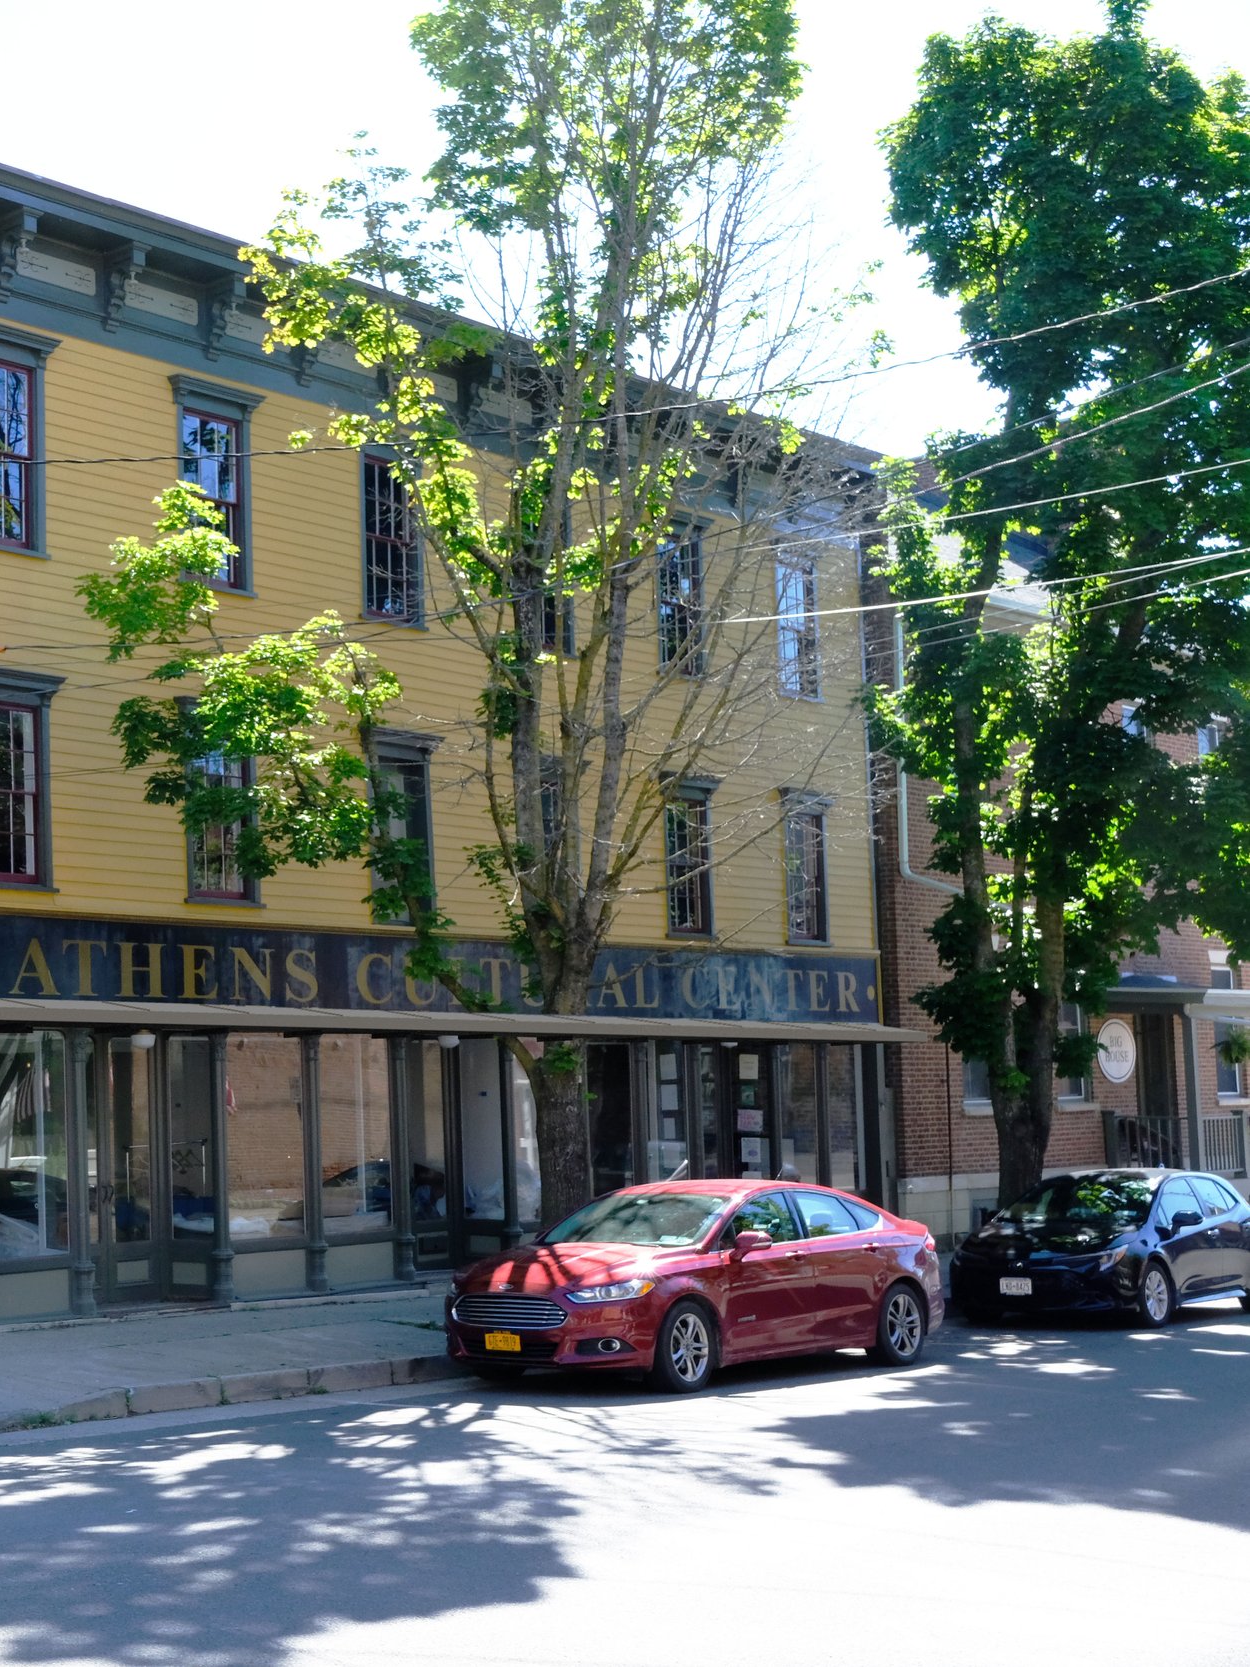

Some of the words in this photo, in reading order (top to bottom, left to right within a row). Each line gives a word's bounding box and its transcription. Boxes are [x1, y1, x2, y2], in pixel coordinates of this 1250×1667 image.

[9, 937, 319, 1002] ATHENS
[681, 963, 861, 1013] CENTER
[1109, 1035, 1123, 1048] BIG
[1105, 1050, 1130, 1063] HOUSE
